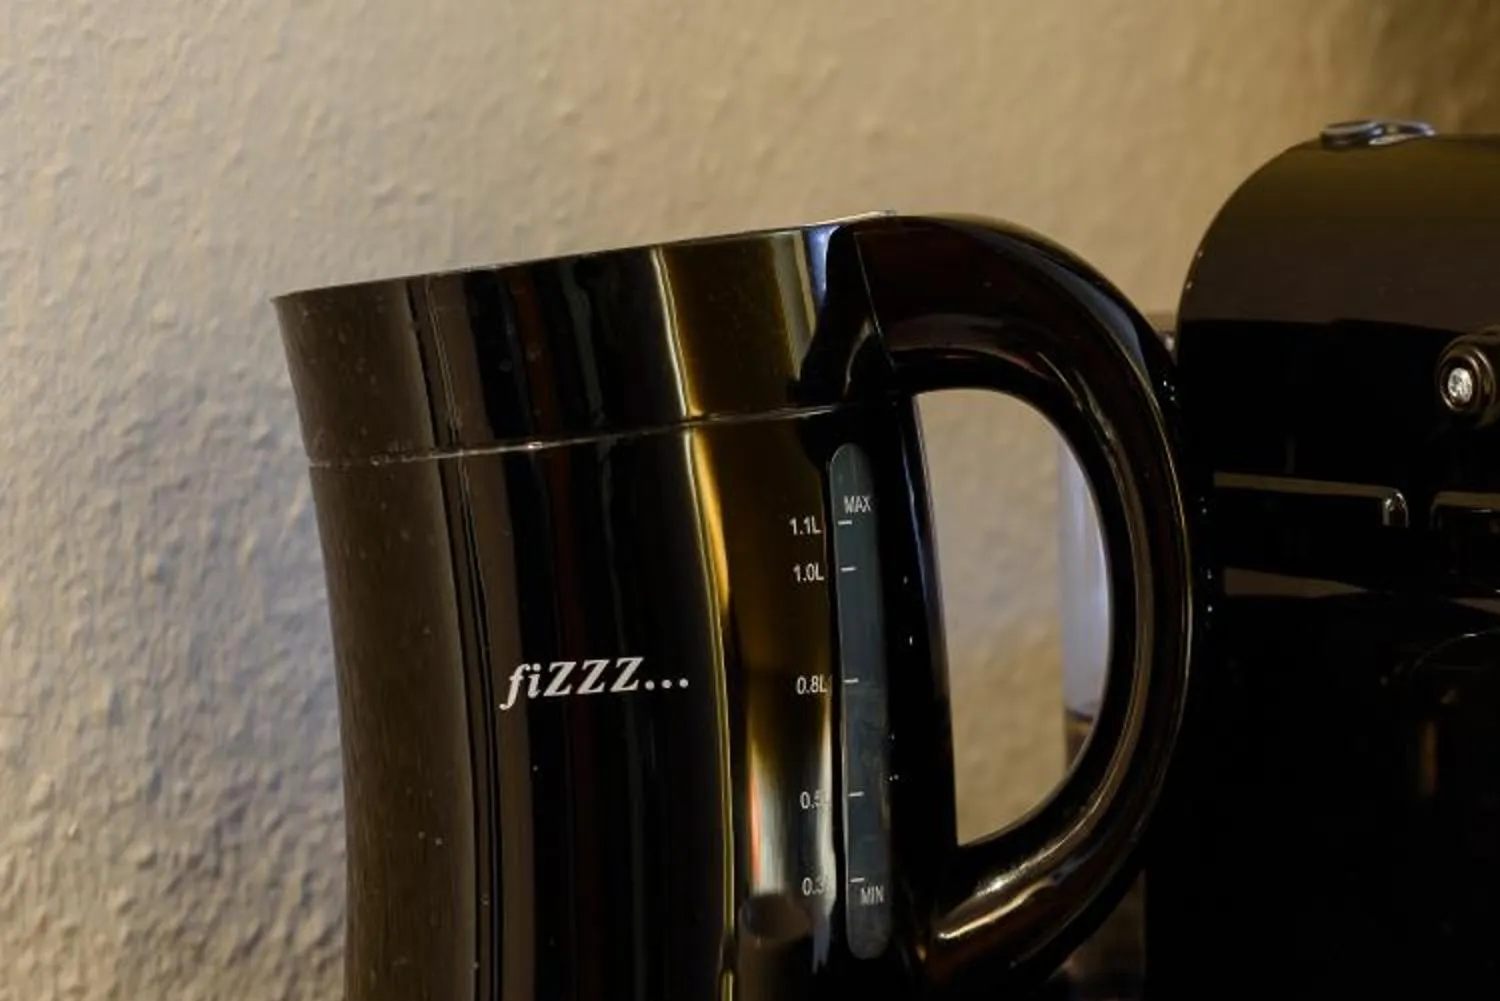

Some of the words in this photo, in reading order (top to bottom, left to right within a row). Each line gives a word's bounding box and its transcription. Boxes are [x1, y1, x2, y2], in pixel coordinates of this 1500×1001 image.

[843, 495, 871, 513] MAX
[789, 515, 822, 536] 1.1L
[792, 563, 825, 582] 1.0L
[796, 674, 829, 695] 0.8L
[861, 884, 884, 905] MIN
